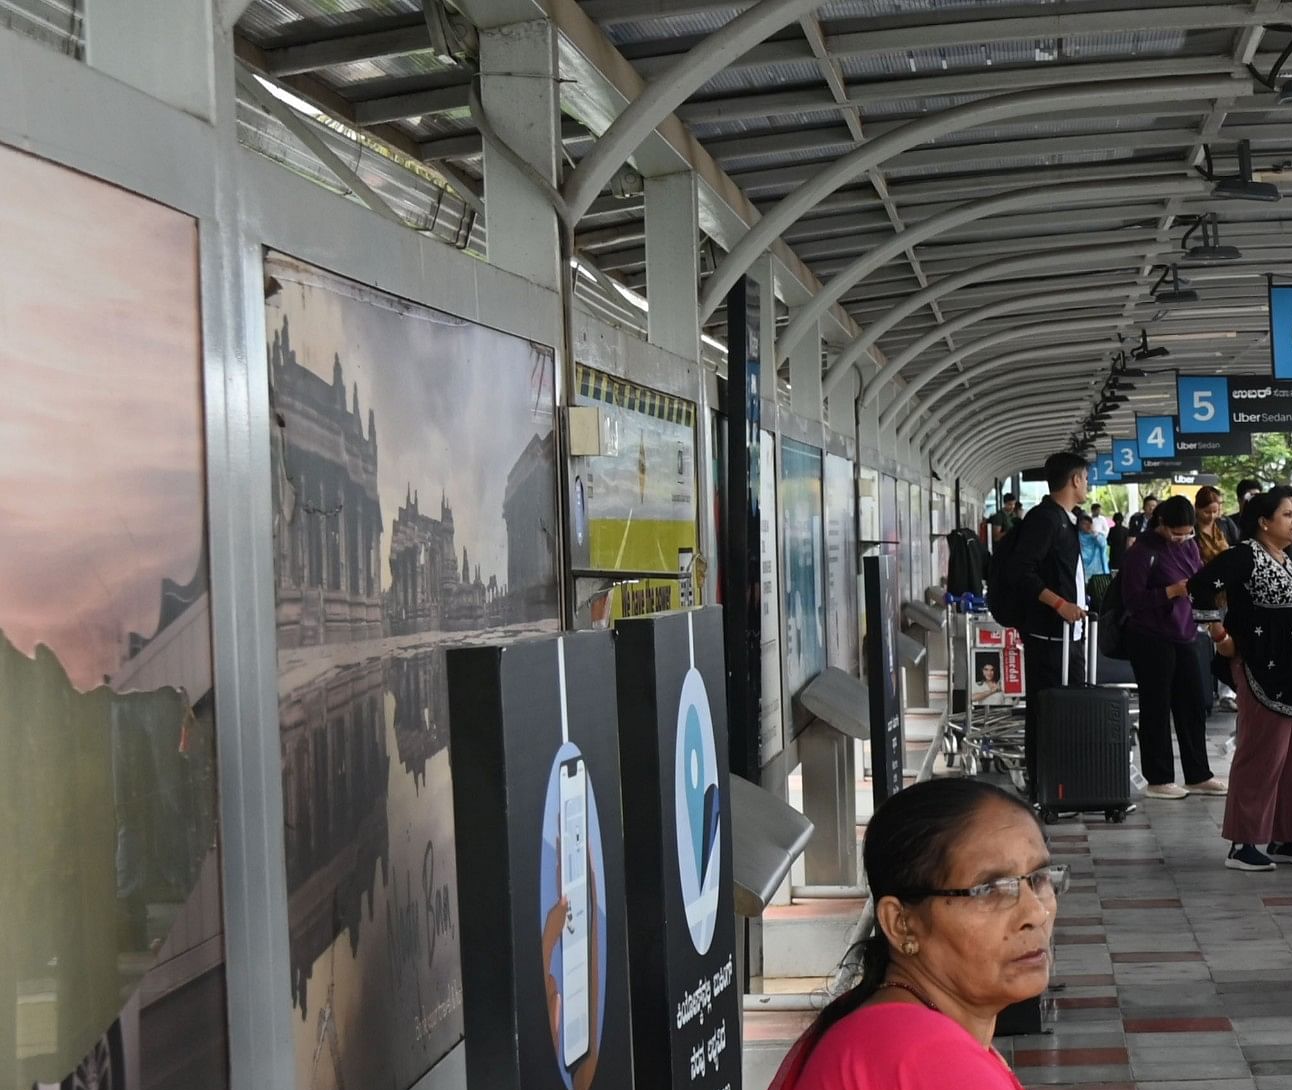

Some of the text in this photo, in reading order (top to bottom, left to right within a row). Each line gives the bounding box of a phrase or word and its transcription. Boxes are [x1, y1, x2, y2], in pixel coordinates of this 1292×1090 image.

[1231, 386, 1272, 399] ಉಬರ್
[1192, 390, 1215, 422] 5
[1146, 426, 1165, 449] 4
[1120, 448, 1134, 466] 3
[1104, 460, 1114, 475] 2
[1174, 474, 1195, 484] Uber
